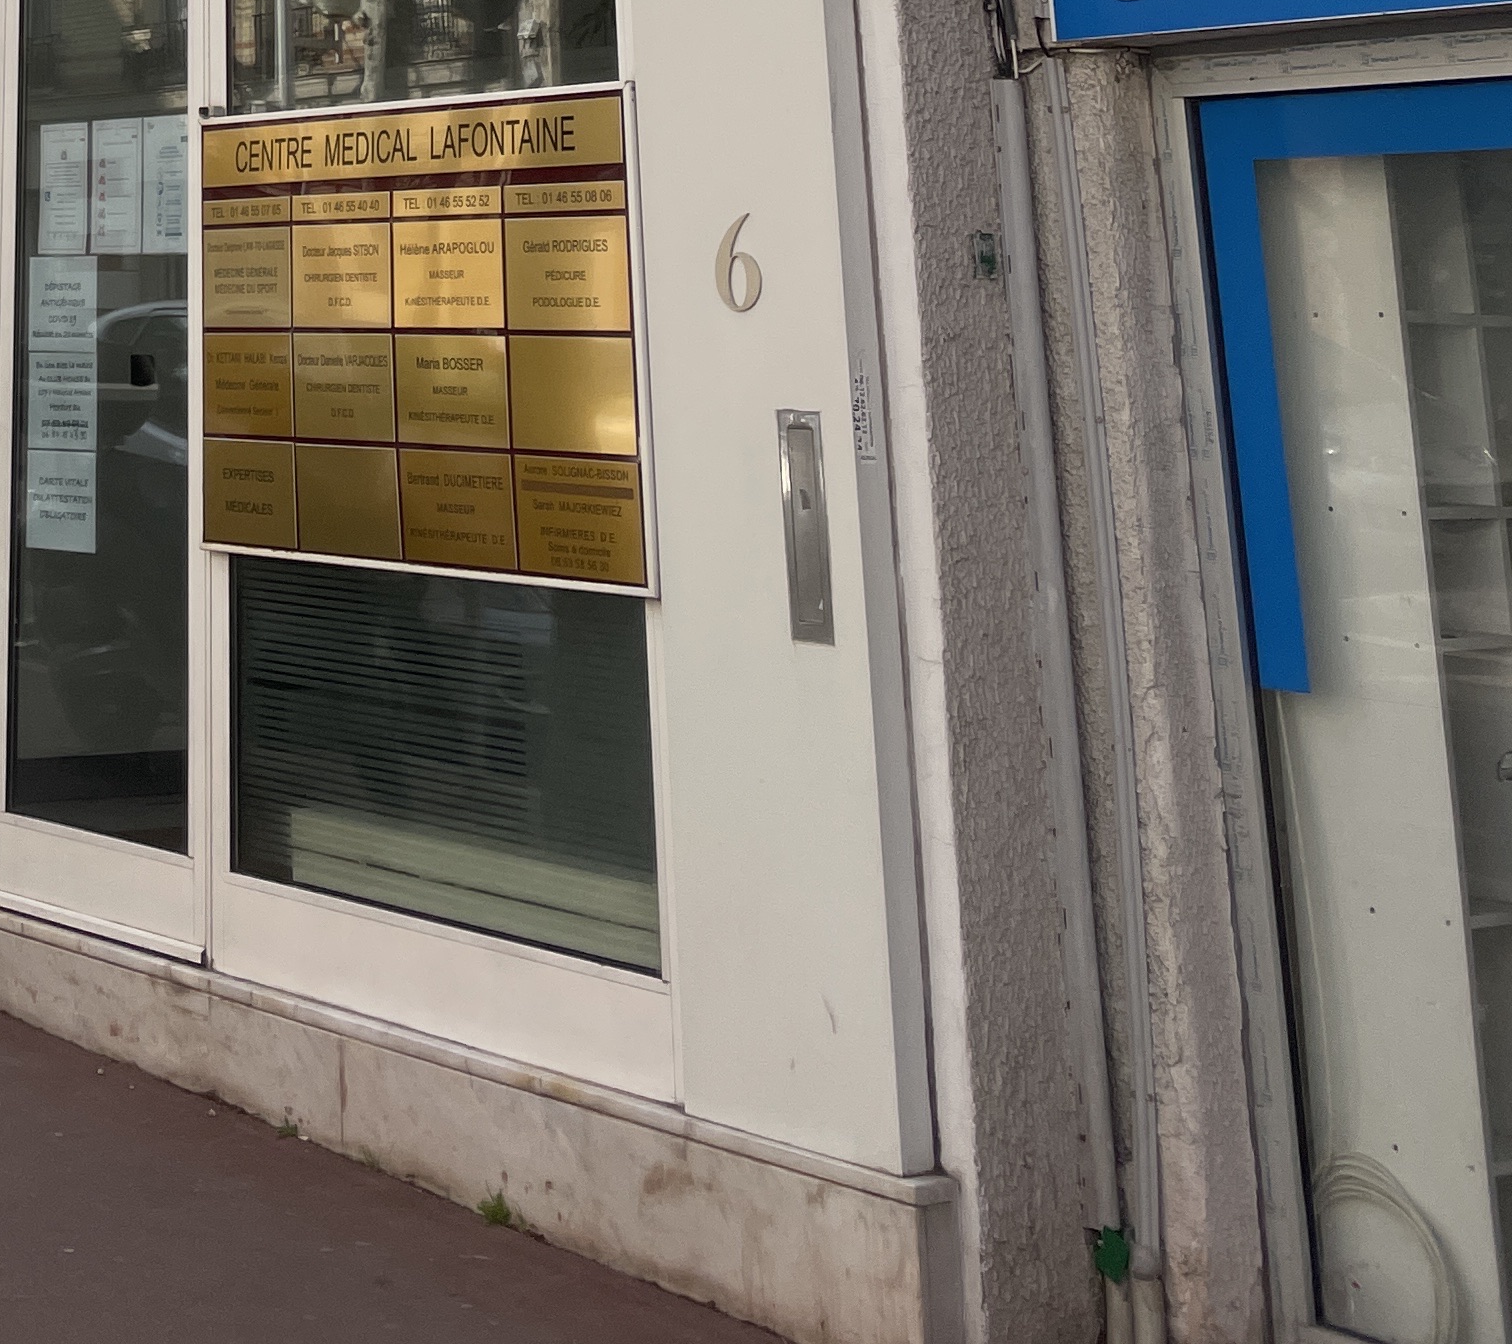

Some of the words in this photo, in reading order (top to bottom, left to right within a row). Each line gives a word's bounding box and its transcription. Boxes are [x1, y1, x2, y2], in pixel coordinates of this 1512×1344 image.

[235, 135, 313, 173] CENTRE
[324, 127, 418, 167] MEDICAL
[430, 115, 576, 160] LAFONTAINE
[427, 196, 437, 209] 01
[439, 196, 451, 208] 46
[453, 195, 464, 208] 55
[465, 195, 477, 207] 52
[479, 194, 490, 207] 52
[542, 192, 553, 205] 01
[556, 191, 568, 204] 46
[570, 190, 583, 203] 55
[585, 190, 597, 203] 08
[599, 189, 612, 202] 06
[323, 201, 332, 213] 01
[333, 201, 344, 213] 46
[345, 200, 356, 212] 55
[357, 200, 368, 211] 40
[369, 199, 380, 211] 40
[303, 246, 326, 258] Docteur
[327, 246, 351, 259] Jacques
[353, 244, 379, 256] SITBON
[400, 243, 430, 256] Hélène
[431, 241, 495, 255] ARAPOGLOU
[522, 240, 551, 253] Gérald
[552, 239, 609, 252] RODRIGUES
[715, 212, 762, 313] 6
[304, 273, 344, 283] CHIRURGIEN
[345, 272, 377, 282] DENTISTE
[428, 270, 464, 280] MASSEUR
[545, 269, 586, 281] PÉDICURE
[532, 297, 584, 308] PODOLOGUE
[297, 353, 319, 366] Docteur
[442, 357, 483, 371] BOSSER
[306, 382, 346, 393] CHIRURGIEN
[347, 384, 381, 394] DENTISTE
[432, 385, 468, 396] MASSEUR
[408, 412, 479, 425] KINÉSITHÉRAPEUTE
[223, 468, 274, 484] EXPERTISES
[552, 465, 629, 481] SOLIGNAC-BISSON
[38, 476, 63, 486] CARTE
[64, 478, 89, 487] VITALE
[406, 471, 440, 487] Bertrand
[443, 473, 504, 490] DUCIMETIERE
[436, 502, 476, 515] MASSEUR
[532, 498, 555, 511] Sarah
